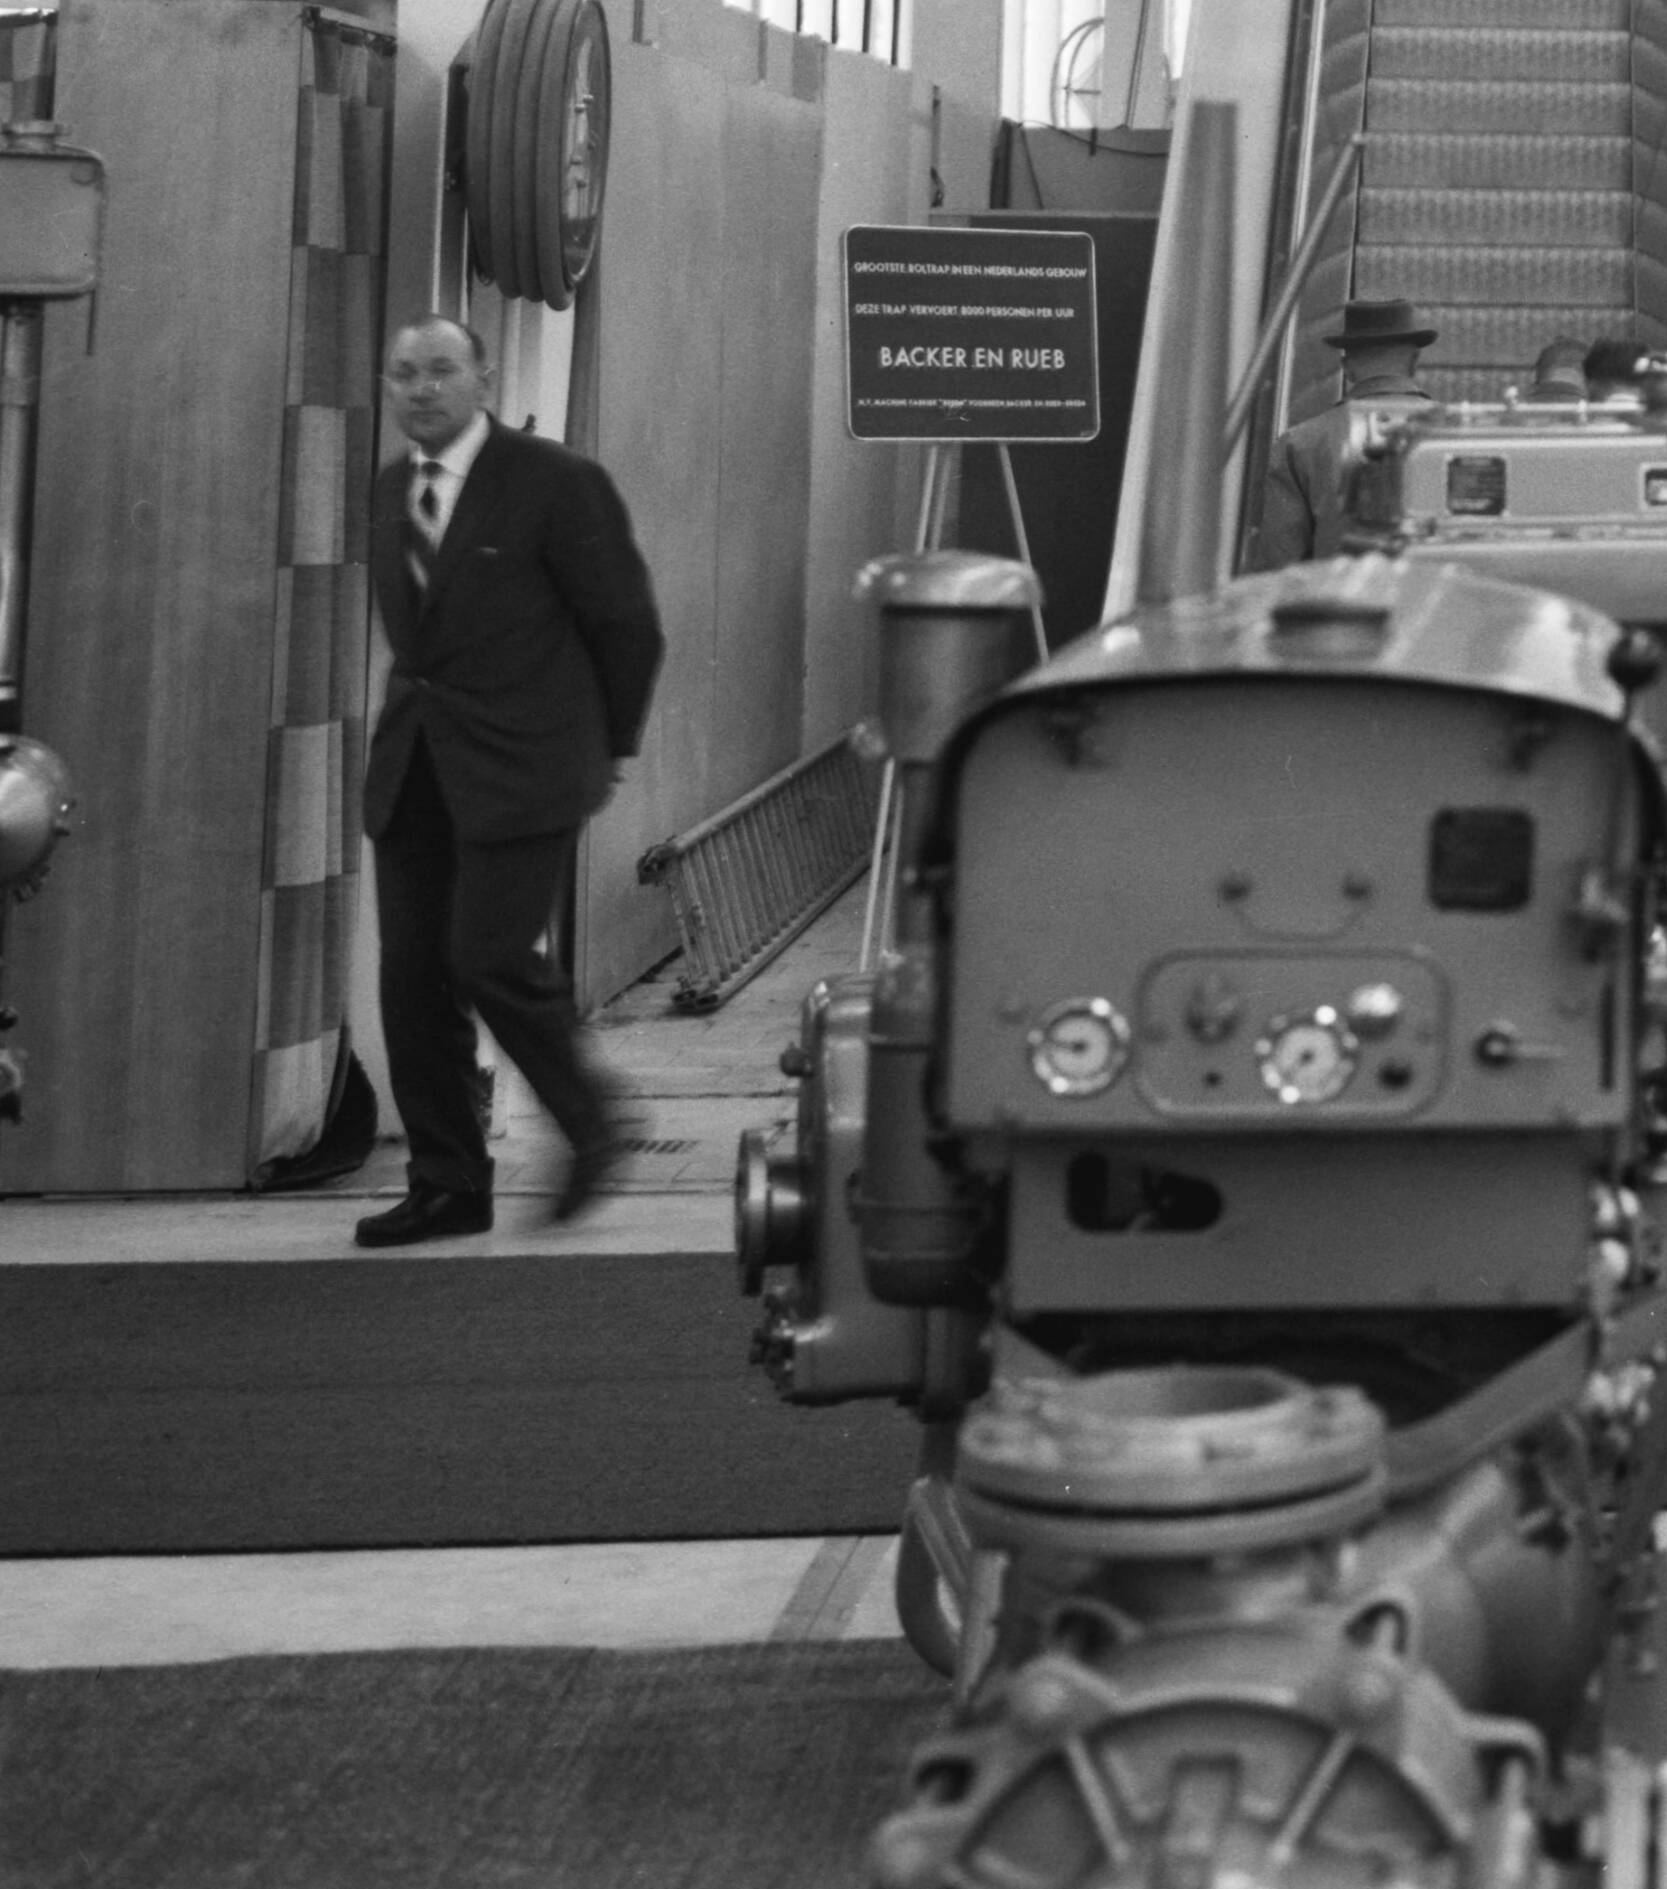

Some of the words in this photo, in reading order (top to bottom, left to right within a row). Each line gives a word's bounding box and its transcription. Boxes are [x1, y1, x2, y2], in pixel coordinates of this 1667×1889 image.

[854, 262, 906, 274] GROOTSTE
[908, 263, 950, 275] ROLTRAP
[984, 266, 1045, 278] NEDERLANDS
[1046, 268, 1087, 279] GEBOUW
[855, 303, 880, 314] DEZE
[879, 345, 967, 368] BACKER
[974, 347, 1004, 369] EN
[1011, 348, 1066, 369] RUEB
